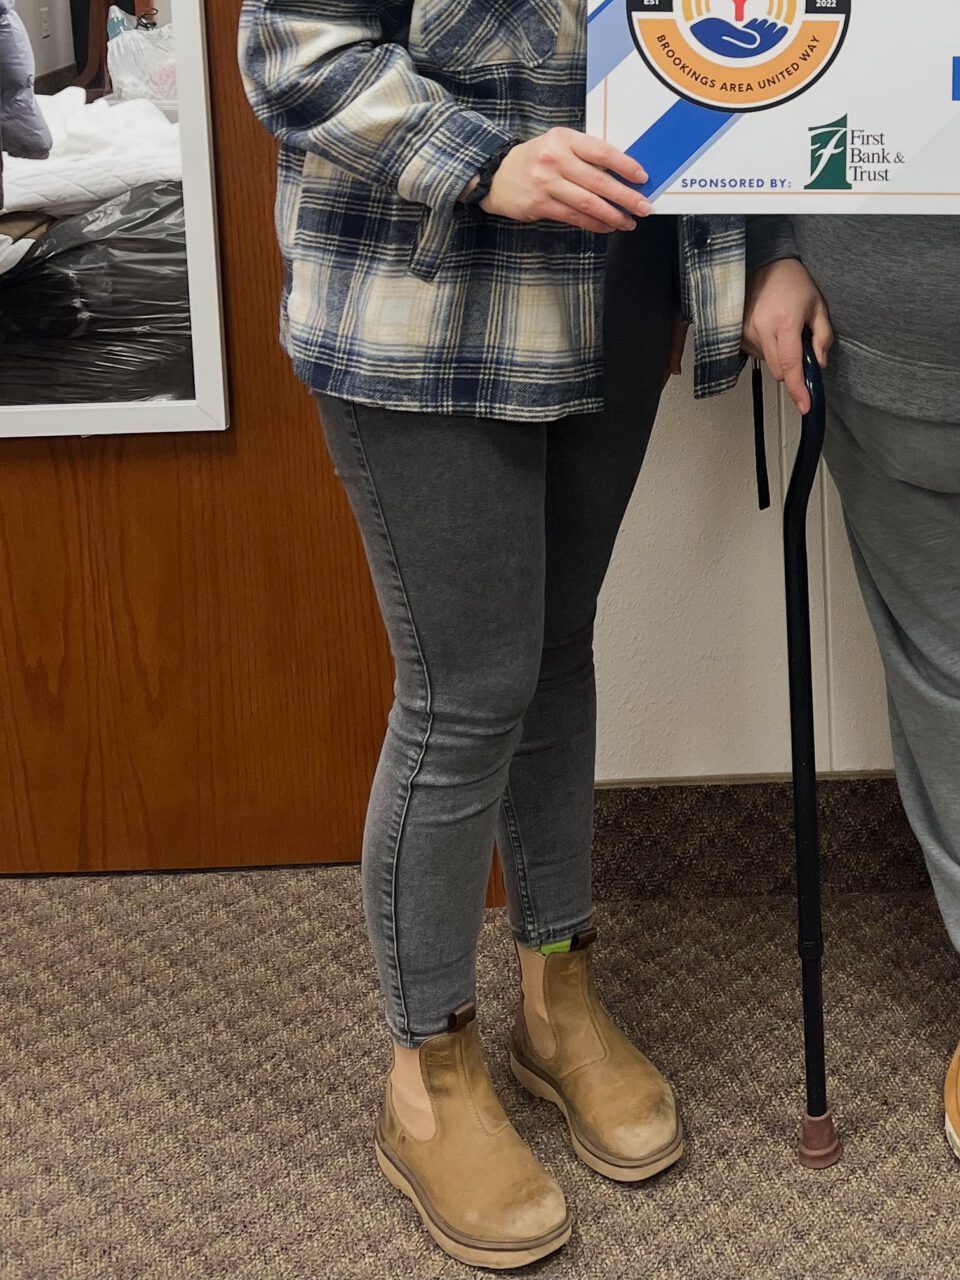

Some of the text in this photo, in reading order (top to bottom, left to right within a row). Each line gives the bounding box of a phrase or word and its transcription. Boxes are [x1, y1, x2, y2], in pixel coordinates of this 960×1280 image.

[815, 0, 837, 8] 2022
[656, 34, 821, 92] BROOKINGS AREA UNITED WAY
[850, 129, 886, 145] First
[849, 148, 905, 164] Bank &
[849, 166, 889, 182] Trust
[681, 178, 792, 188] SPONSORED BY:
